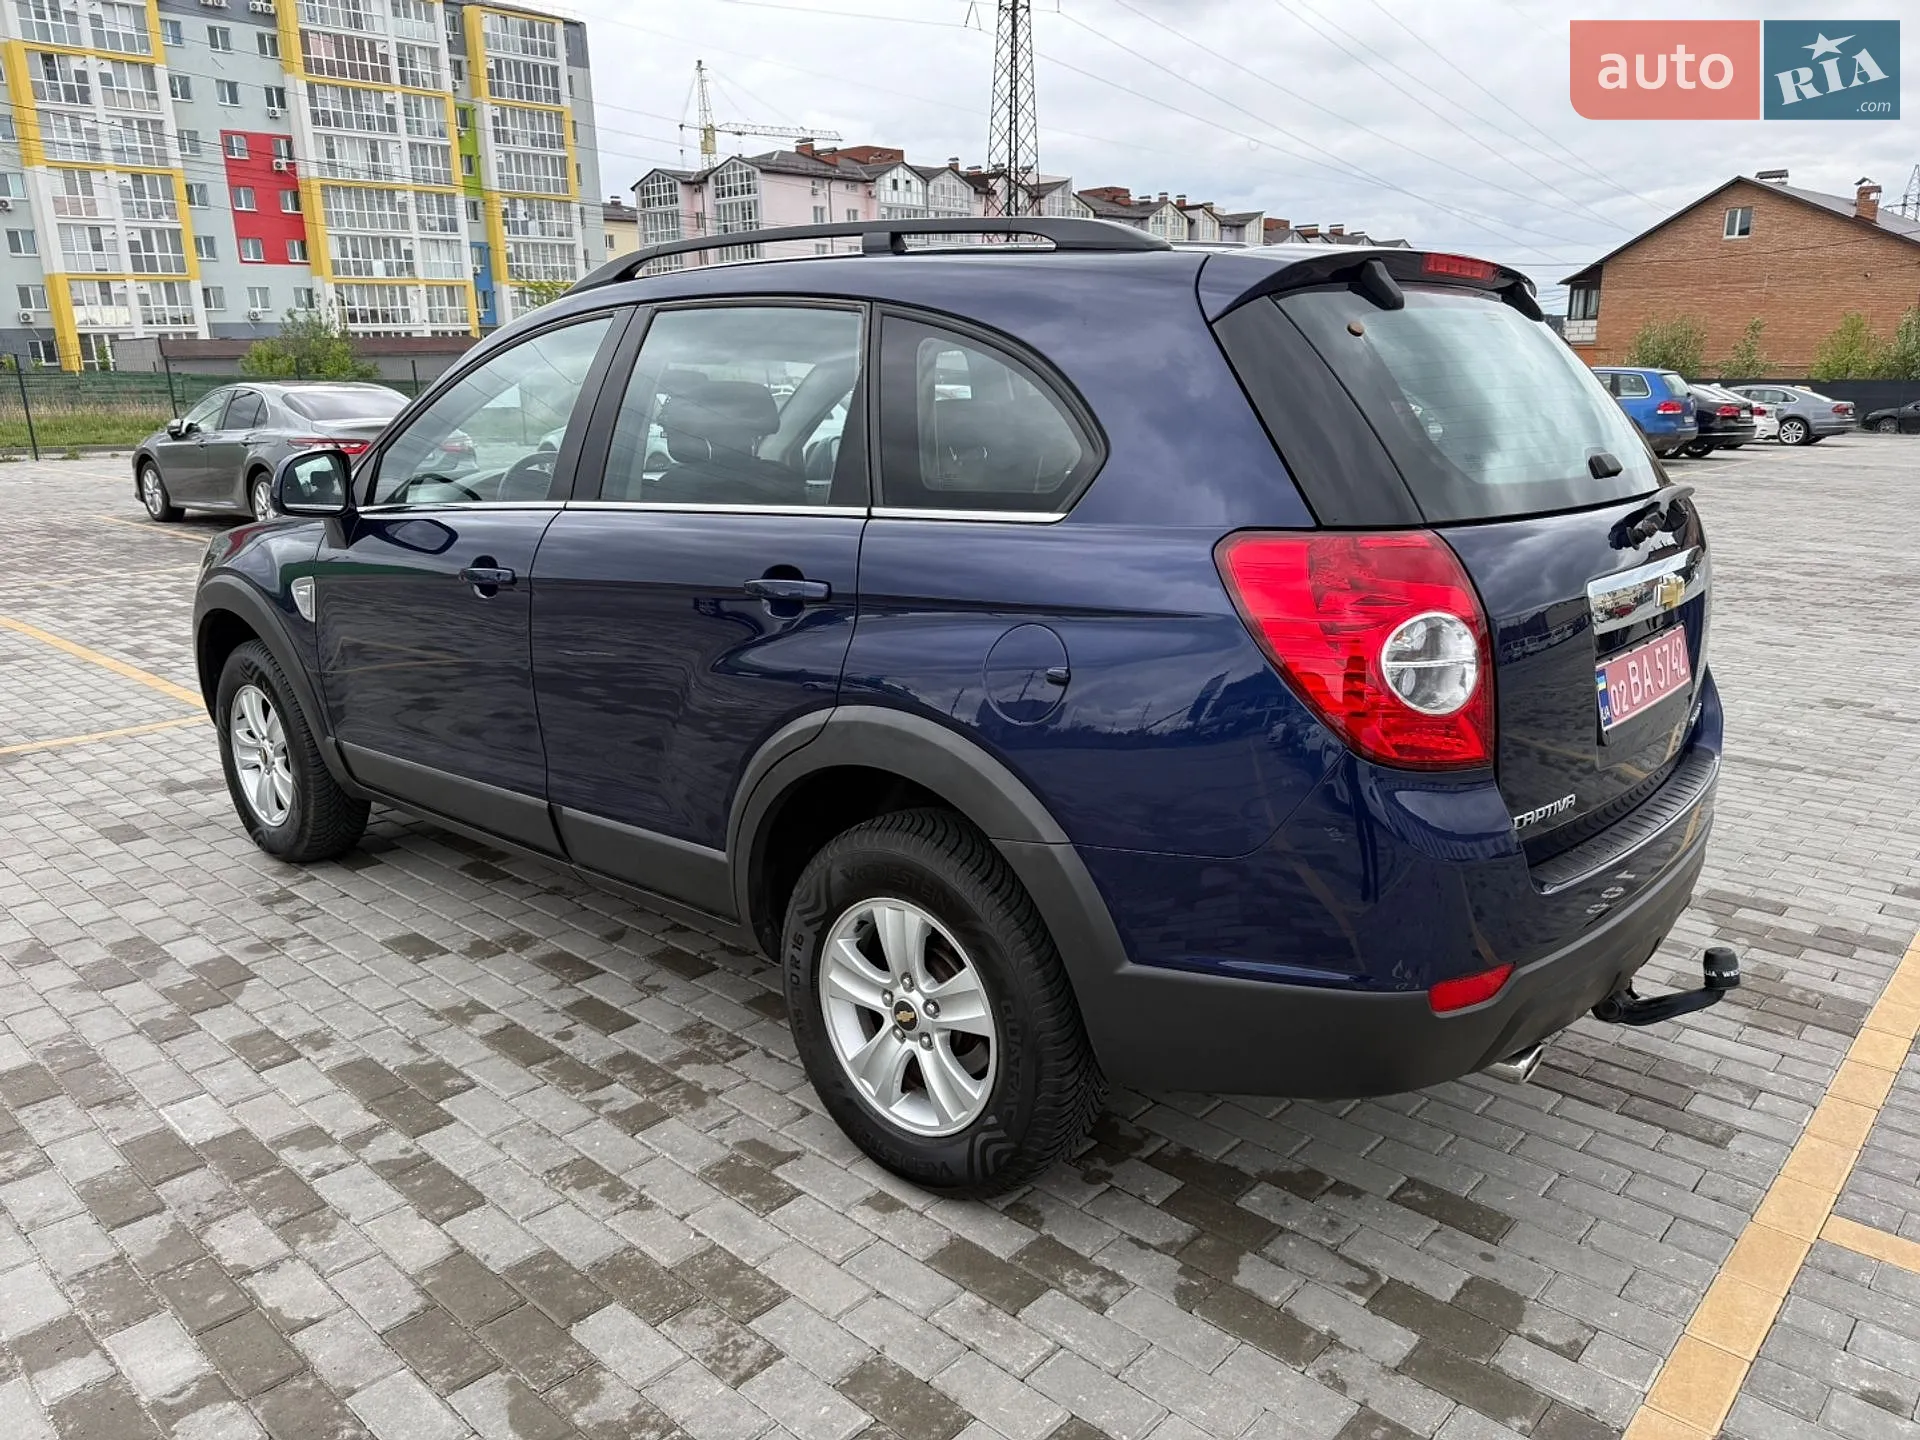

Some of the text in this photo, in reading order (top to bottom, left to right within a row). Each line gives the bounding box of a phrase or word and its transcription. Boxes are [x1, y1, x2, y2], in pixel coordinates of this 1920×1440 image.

[1610, 680, 1629, 717] 02
[1628, 654, 1655, 705] BA
[1655, 637, 1687, 689] 5742
[1513, 793, 1576, 831] CAPTIVA
[1000, 999, 1027, 1122] QUATRAC
